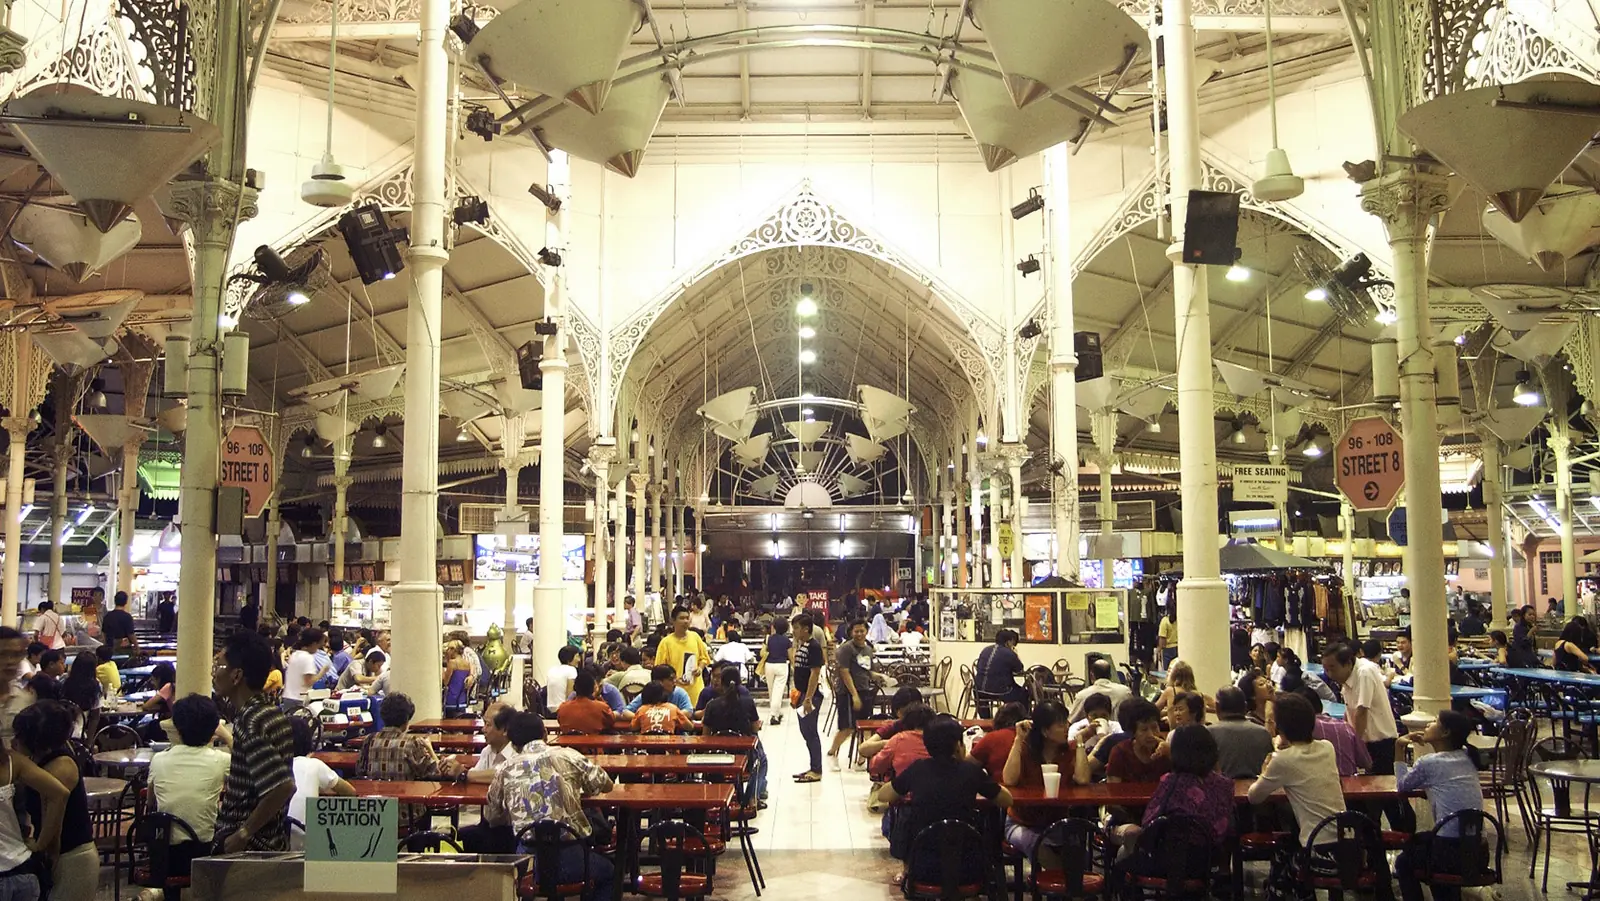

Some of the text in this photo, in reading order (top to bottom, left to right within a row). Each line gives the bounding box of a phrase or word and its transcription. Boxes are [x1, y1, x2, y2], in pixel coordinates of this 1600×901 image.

[227, 441, 240, 454] 96
[248, 443, 264, 456] 108
[1348, 436, 1363, 450] 96
[1374, 433, 1393, 447] 108
[1342, 450, 1400, 477] STREET 8
[222, 461, 269, 482] STREET 8
[1234, 467, 1286, 477] FREE SEATING
[73, 589, 92, 598] TAKE
[808, 591, 827, 600] TAKE
[316, 798, 388, 813] CUTLERY
[317, 813, 381, 826] STATION
